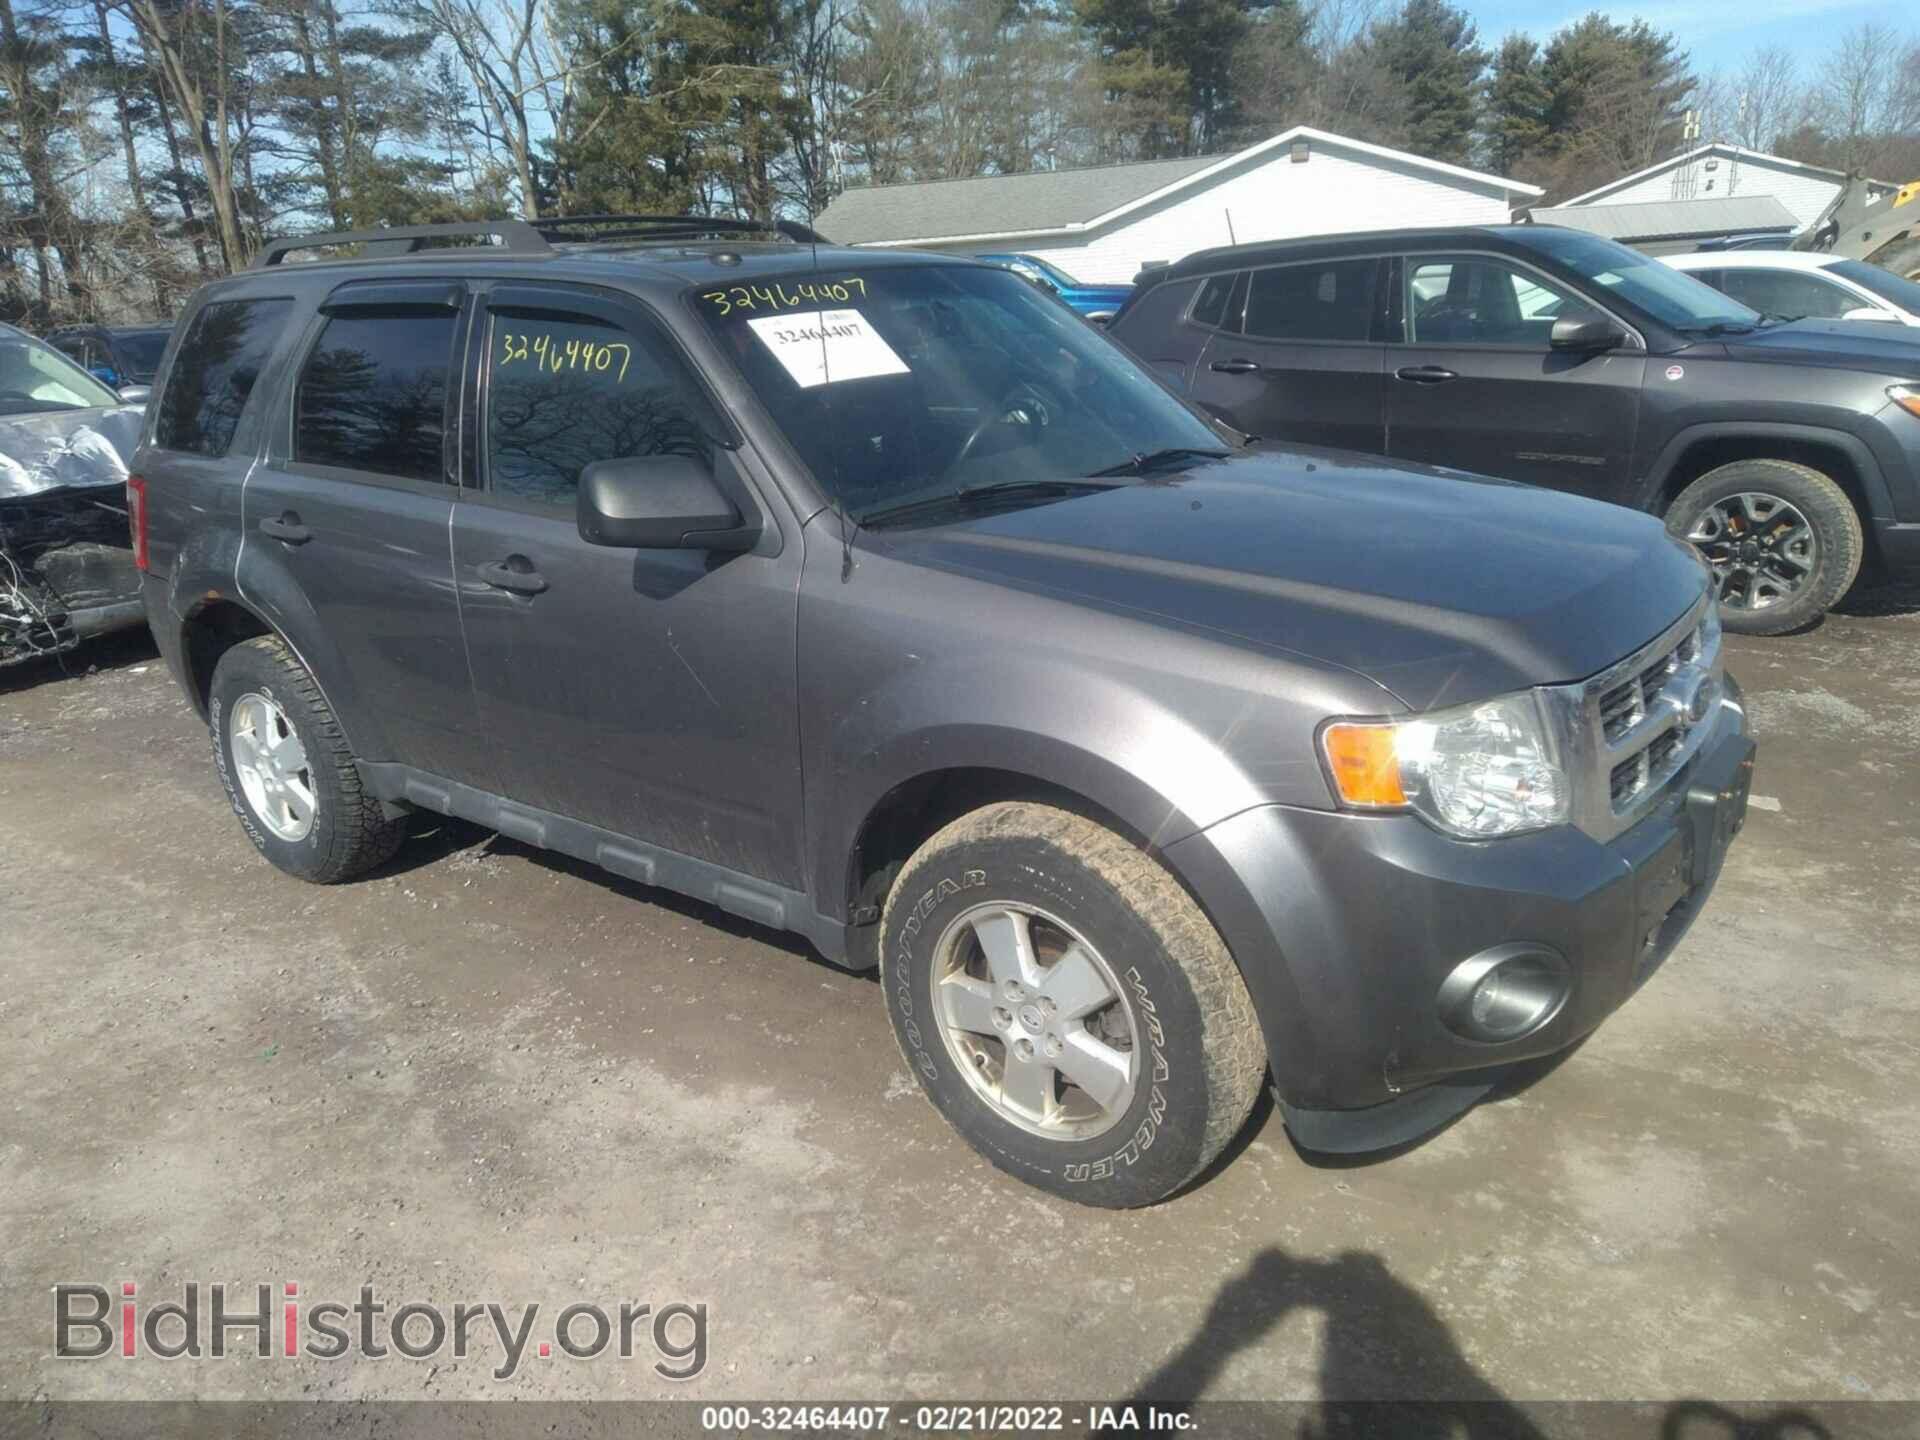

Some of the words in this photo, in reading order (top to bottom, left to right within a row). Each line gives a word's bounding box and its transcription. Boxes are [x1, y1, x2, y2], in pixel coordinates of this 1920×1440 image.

[703, 278, 867, 316] 32464407
[773, 323, 863, 344] 32464407
[501, 334, 631, 384] 32464407
[897, 868, 987, 1081] GOODYEAR
[1063, 965, 1169, 1183] WRANGLER
